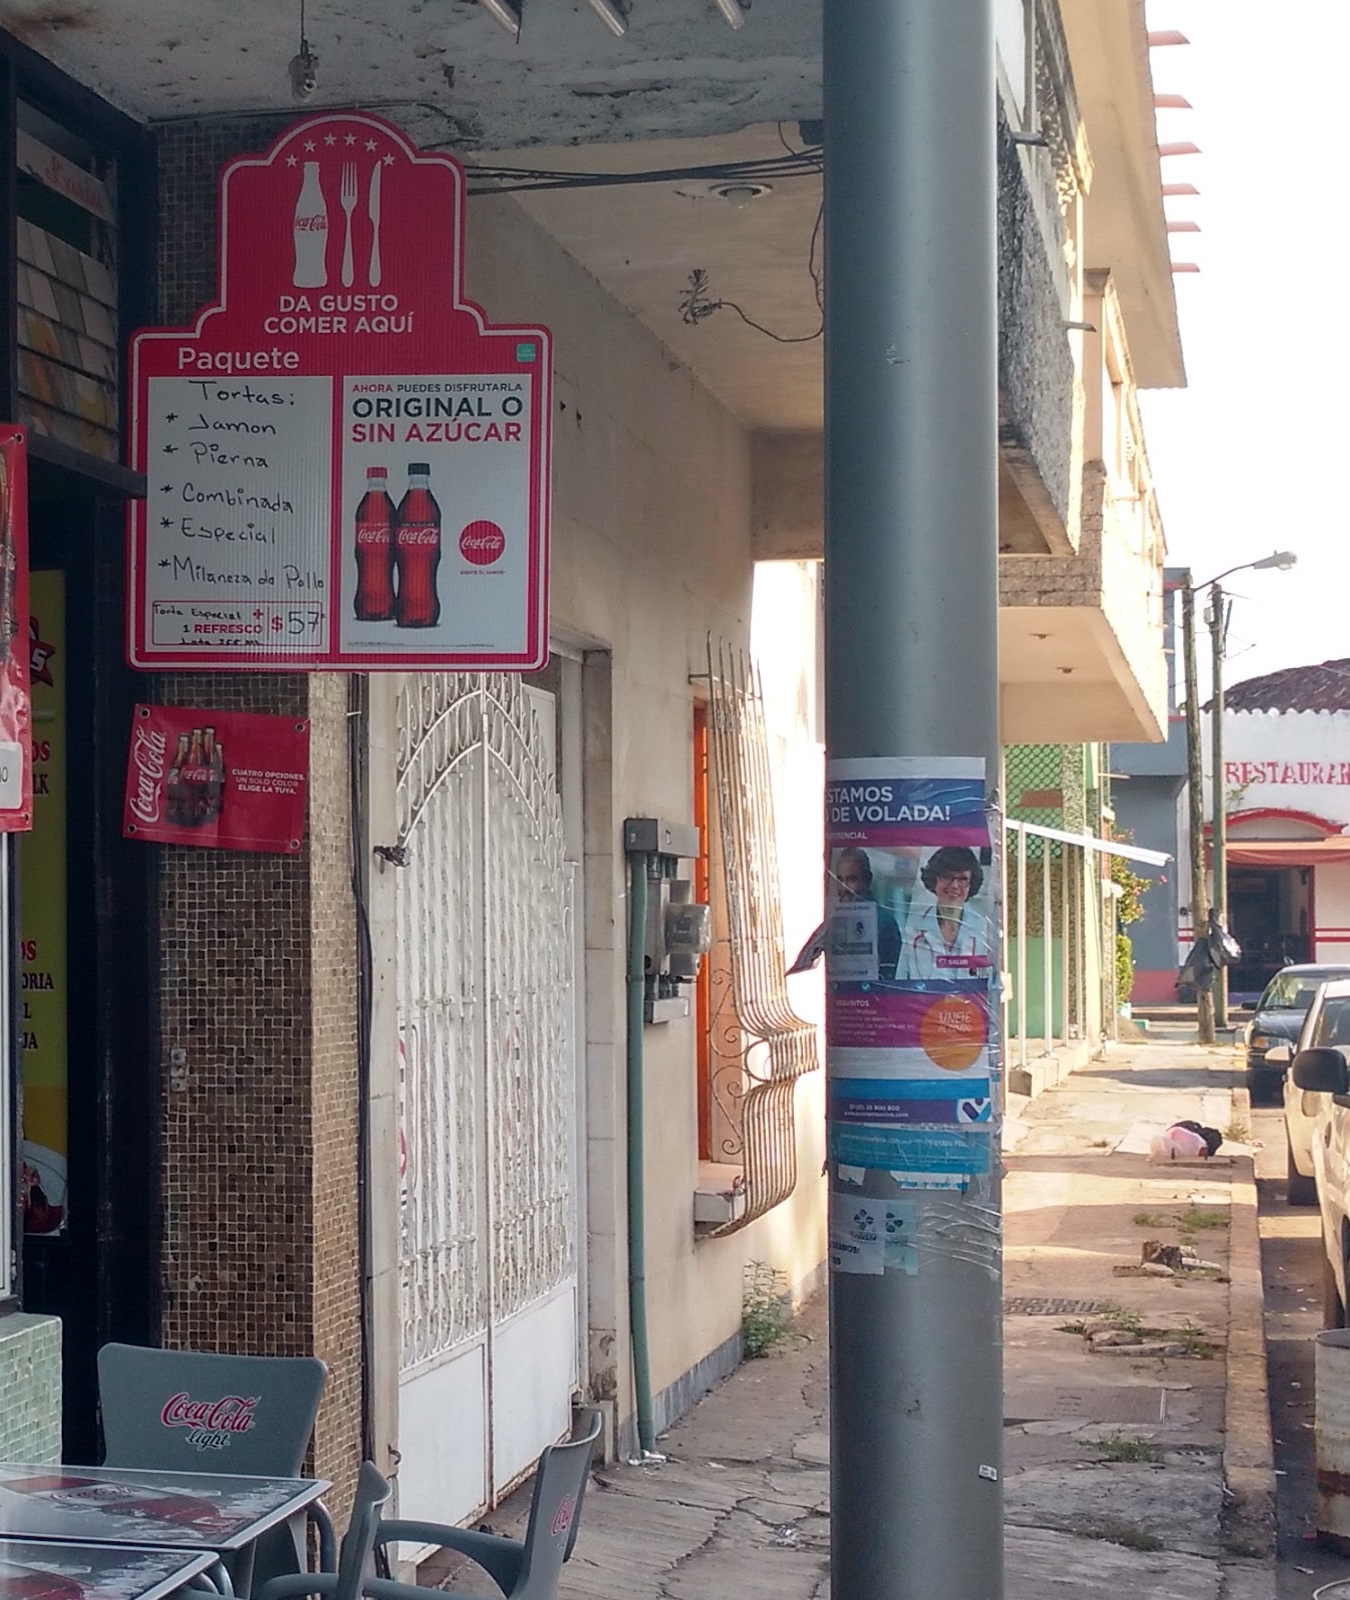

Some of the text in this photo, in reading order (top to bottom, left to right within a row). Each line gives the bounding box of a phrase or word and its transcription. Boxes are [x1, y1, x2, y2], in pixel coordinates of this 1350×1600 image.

[279, 294, 399, 313] DA GUSTO
[264, 311, 415, 334] COMER AQUÍ
[178, 347, 300, 373] Paquete
[188, 380, 295, 406] Tortas:
[352, 383, 523, 393] AHORA PUEDES DISFRUTARLA
[352, 396, 523, 418] ORIGINAL O
[188, 413, 277, 435] Jamon
[352, 417, 522, 443] SIN AZÚCAR
[189, 441, 269, 468] Pierna
[181, 482, 294, 514] Combinada
[181, 517, 276, 544] Especial
[398, 528, 438, 545] Coca-Cola
[461, 535, 502, 550] Coca-Cola
[283, 564, 325, 589] Pollo
[194, 624, 262, 634] REFRESCO
[130, 725, 166, 823] Coca-Cola
[231, 768, 263, 777] CUATRO
[250, 777, 269, 785] SOLO
[832, 804, 951, 822] DE VOLADA!
[160, 1392, 262, 1432] Coca-Cola
[185, 1427, 232, 1452] light
